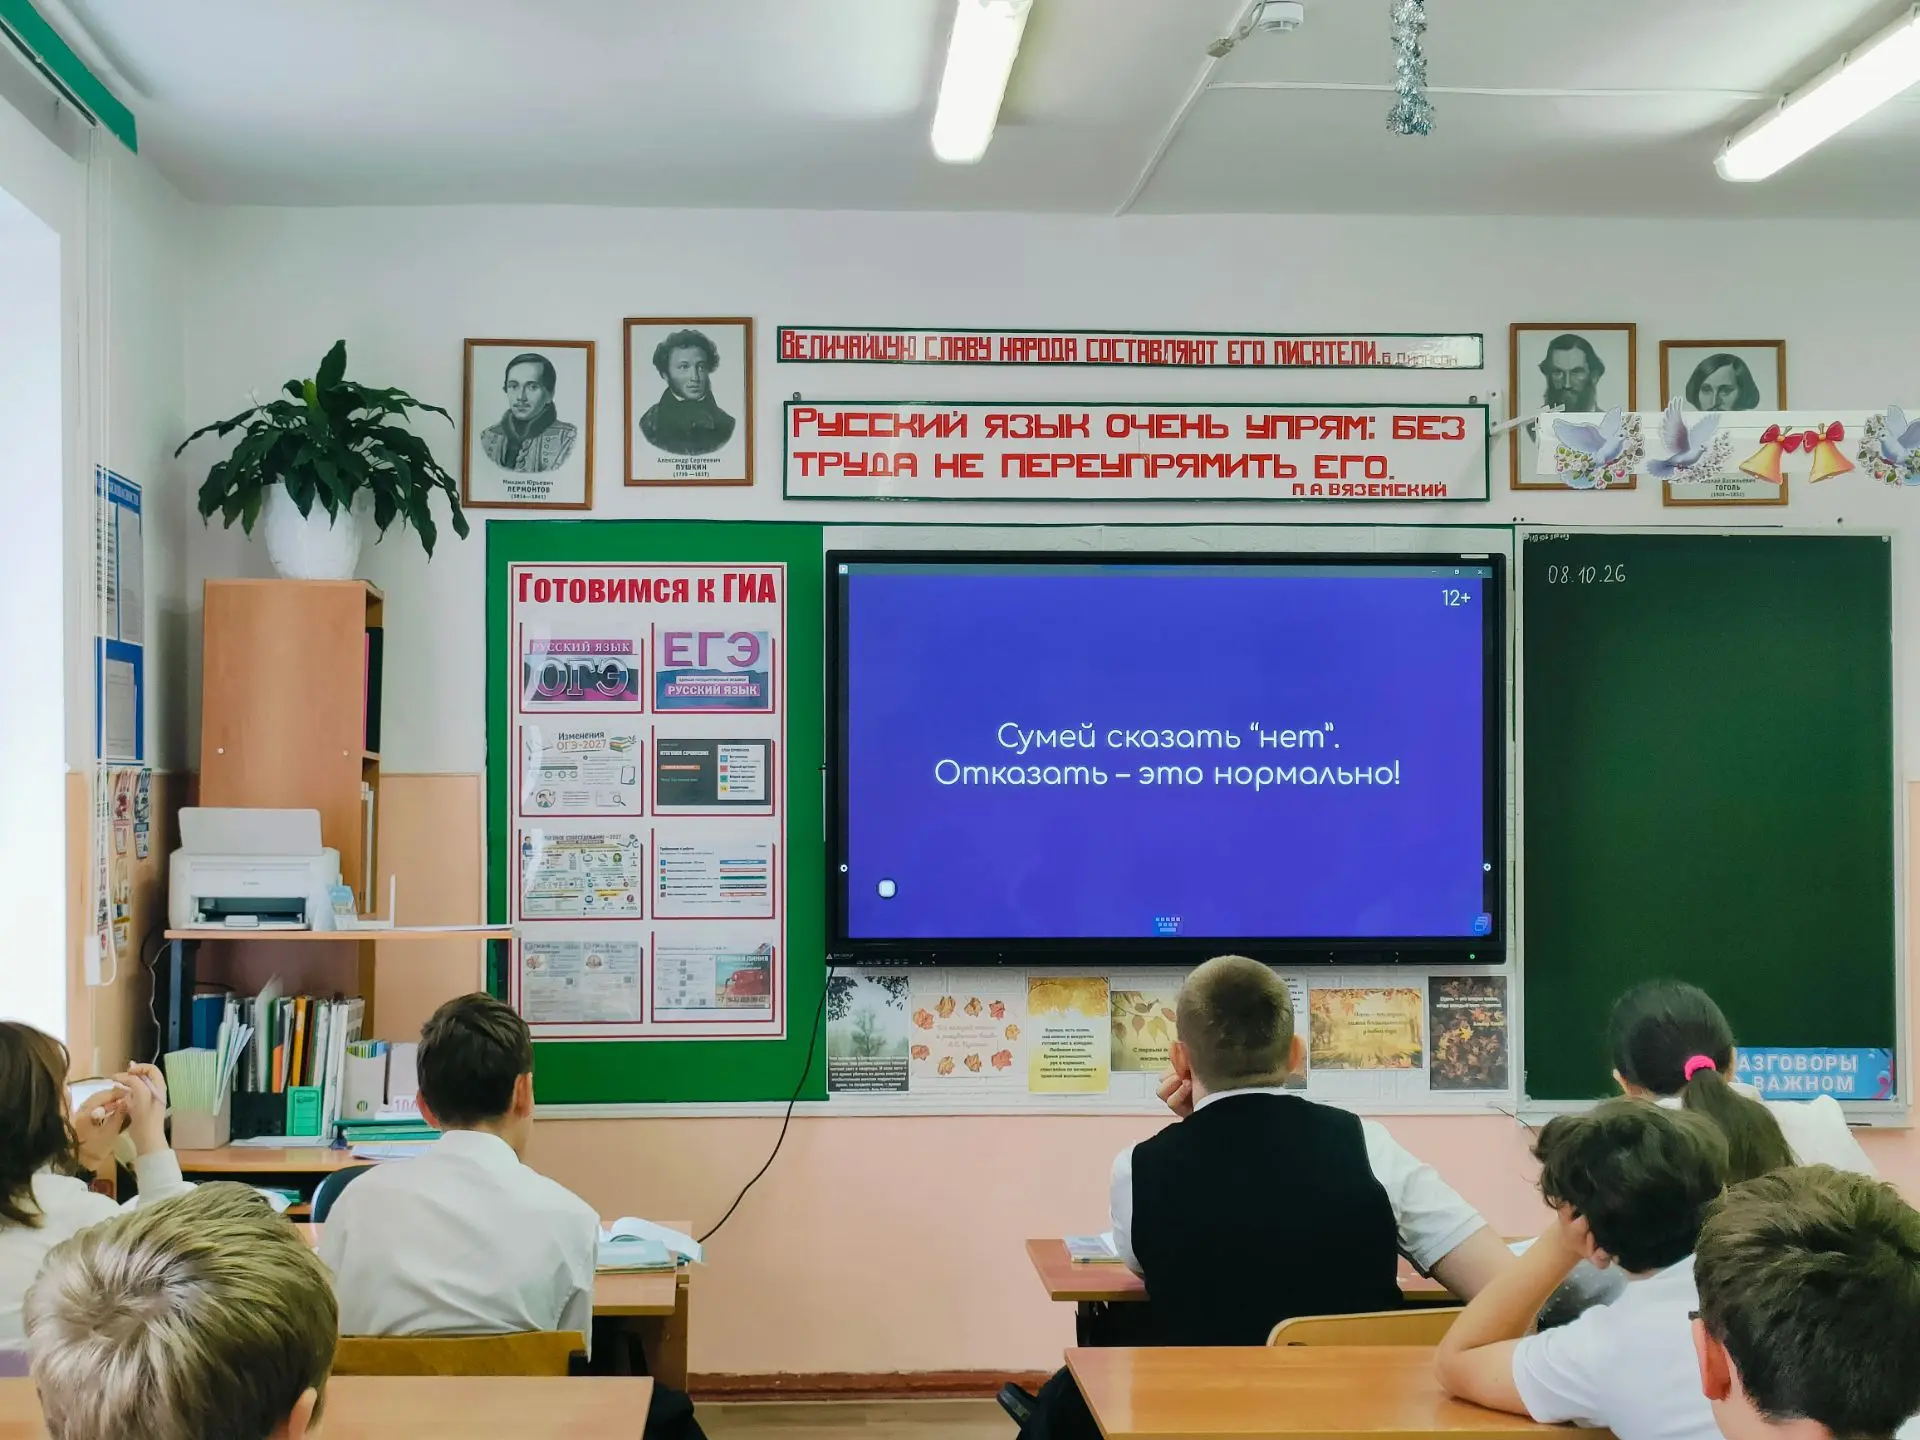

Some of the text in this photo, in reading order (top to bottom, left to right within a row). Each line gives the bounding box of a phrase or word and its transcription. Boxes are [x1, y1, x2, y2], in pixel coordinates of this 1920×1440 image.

[782, 331, 917, 360] ВЕЛИЧАЙШУЮ
[924, 336, 992, 362] СЛАВУ
[999, 337, 1078, 363] НАРОДА
[1086, 338, 1219, 364] СОСТАВЛЯЮТ
[1227, 340, 1266, 365] ЕГО
[1274, 340, 1381, 366] ПИСАТЕЛИ.
[793, 408, 1465, 441] РУССКИЙ ЯЗЫК ОЧЕНЬ УПРЯМ: БЕЗ
[793, 451, 1396, 481] ТРУДА НЕ ПЕРЕУПРЯМИТЬ ЕГО.
[1328, 481, 1448, 497] ВЯЗЕМСКИЙ
[723, 573, 777, 604] ГИА
[1441, 589, 1472, 606] 12+
[532, 641, 631, 653] РУССКИЙ ЯЗЫК
[664, 631, 761, 668] ЕГЭ
[534, 657, 629, 697] ОГЭ
[667, 684, 758, 695] РУССКИЙ ЯЗЫК
[556, 738, 607, 751] ОГЭ-2027
[558, 731, 605, 741] Изменения
[997, 722, 1097, 754] Сумей
[1106, 730, 1241, 750] сказать
[934, 758, 1109, 786] Отказать
[1138, 766, 1204, 786] это
[1214, 759, 1401, 792] нормально!
[1737, 1053, 1859, 1073] АЗГОВОРЫ
[1753, 1074, 1855, 1093] ВАЖНОМ
